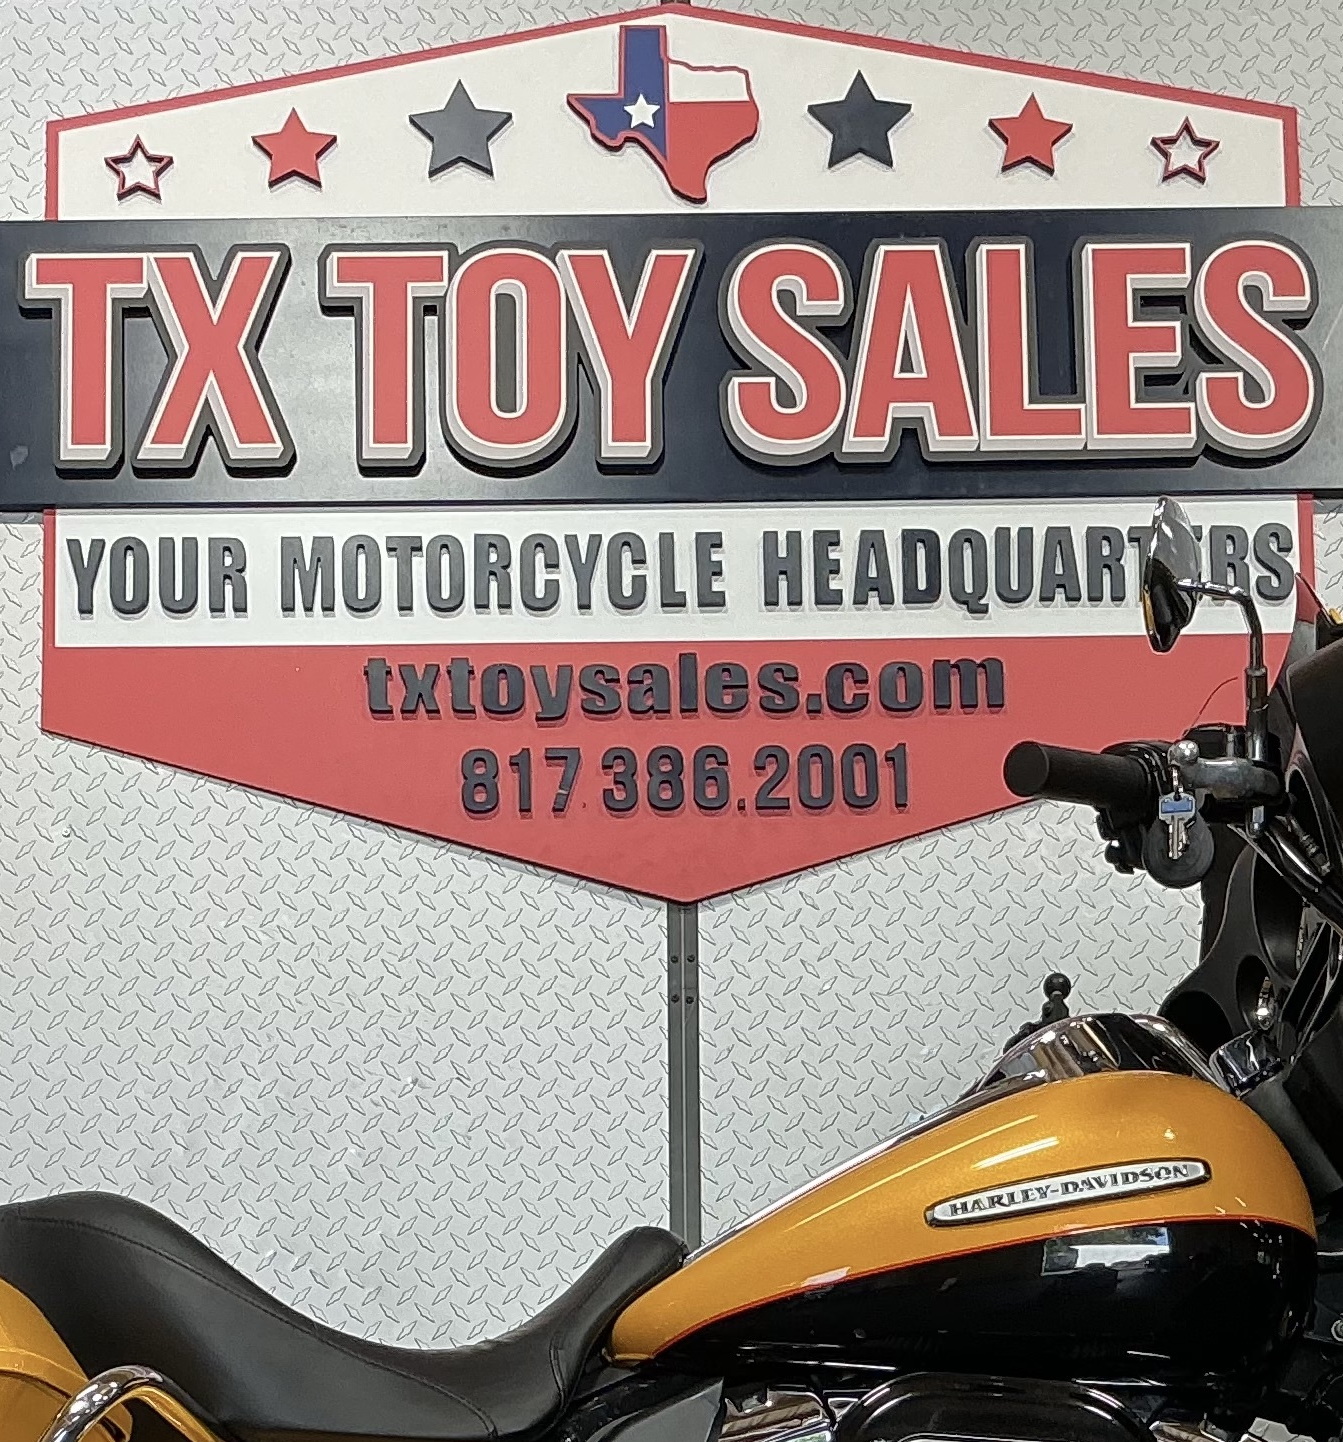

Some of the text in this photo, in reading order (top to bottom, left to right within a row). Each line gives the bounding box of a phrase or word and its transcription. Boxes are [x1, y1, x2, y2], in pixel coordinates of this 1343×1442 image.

[22, 238, 1318, 467] TX TOY SALES
[65, 522, 1295, 616] YOUR MOTORCYCLE HEADQUARRS
[363, 653, 1006, 721] txtoysales.com
[948, 1163, 1190, 1217] HARLEY-DAVIDSON
